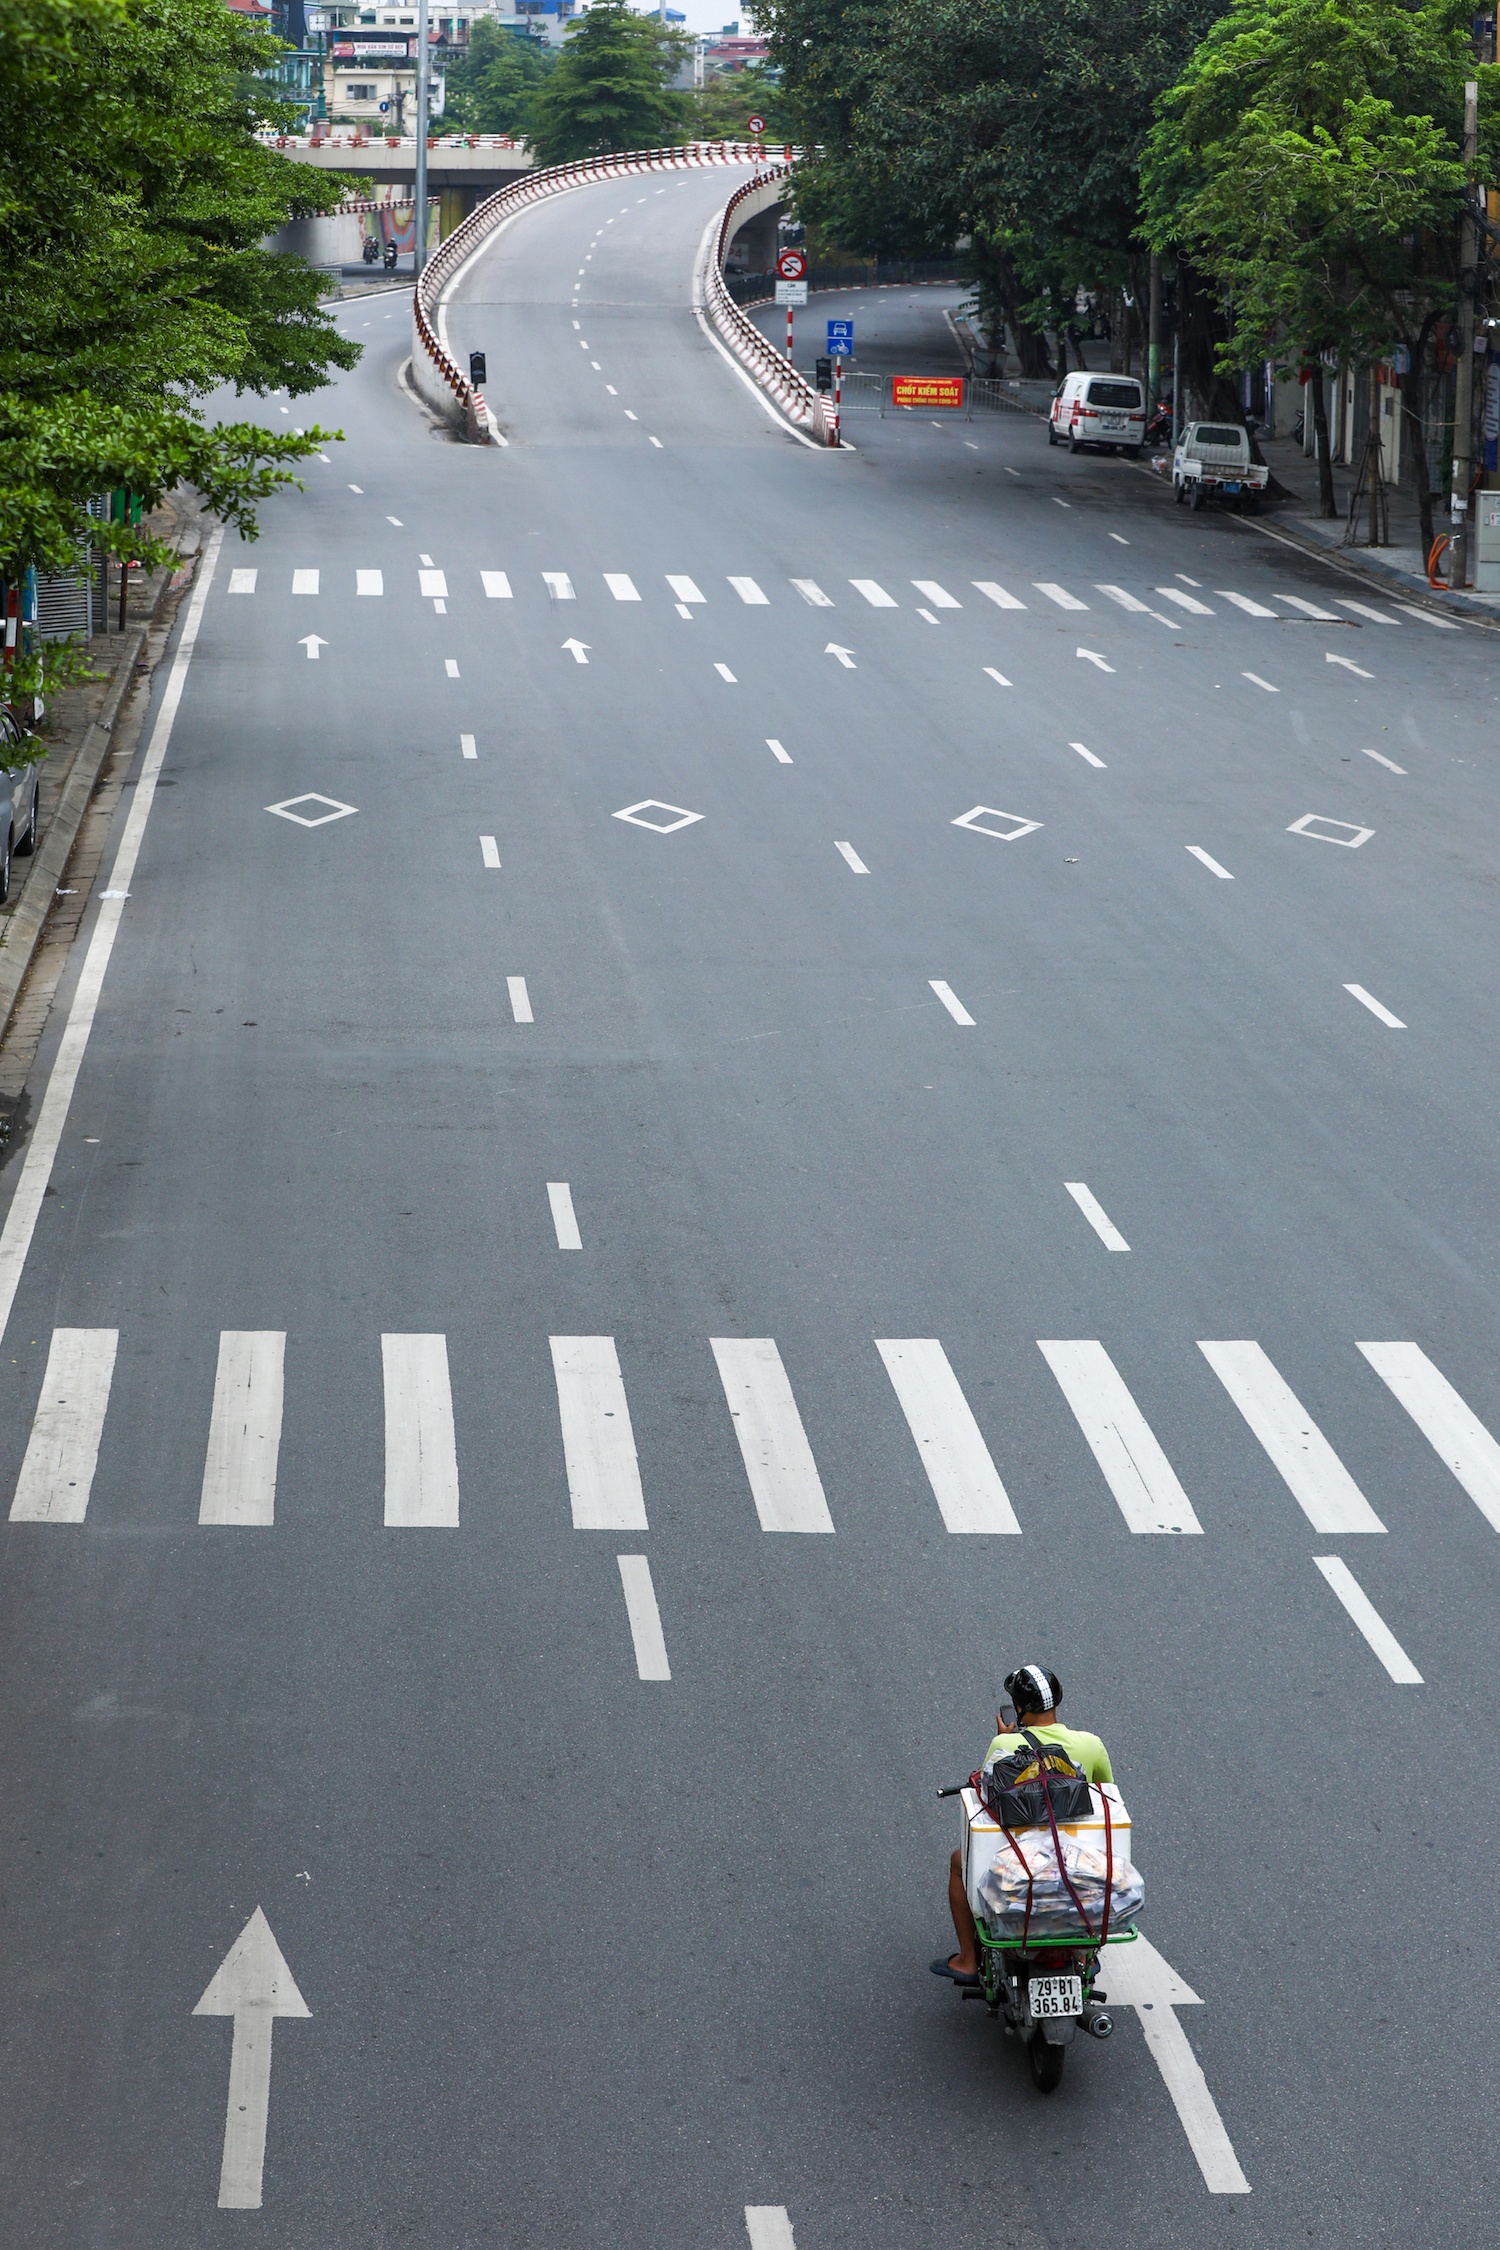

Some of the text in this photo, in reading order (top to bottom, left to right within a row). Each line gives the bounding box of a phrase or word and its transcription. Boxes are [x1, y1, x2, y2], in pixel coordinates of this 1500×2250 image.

[897, 384, 959, 396] CHỐT KIỂM SOÁT
[1037, 1979, 1073, 1996] 29-B1
[1034, 1996, 1078, 2014] 365.84
